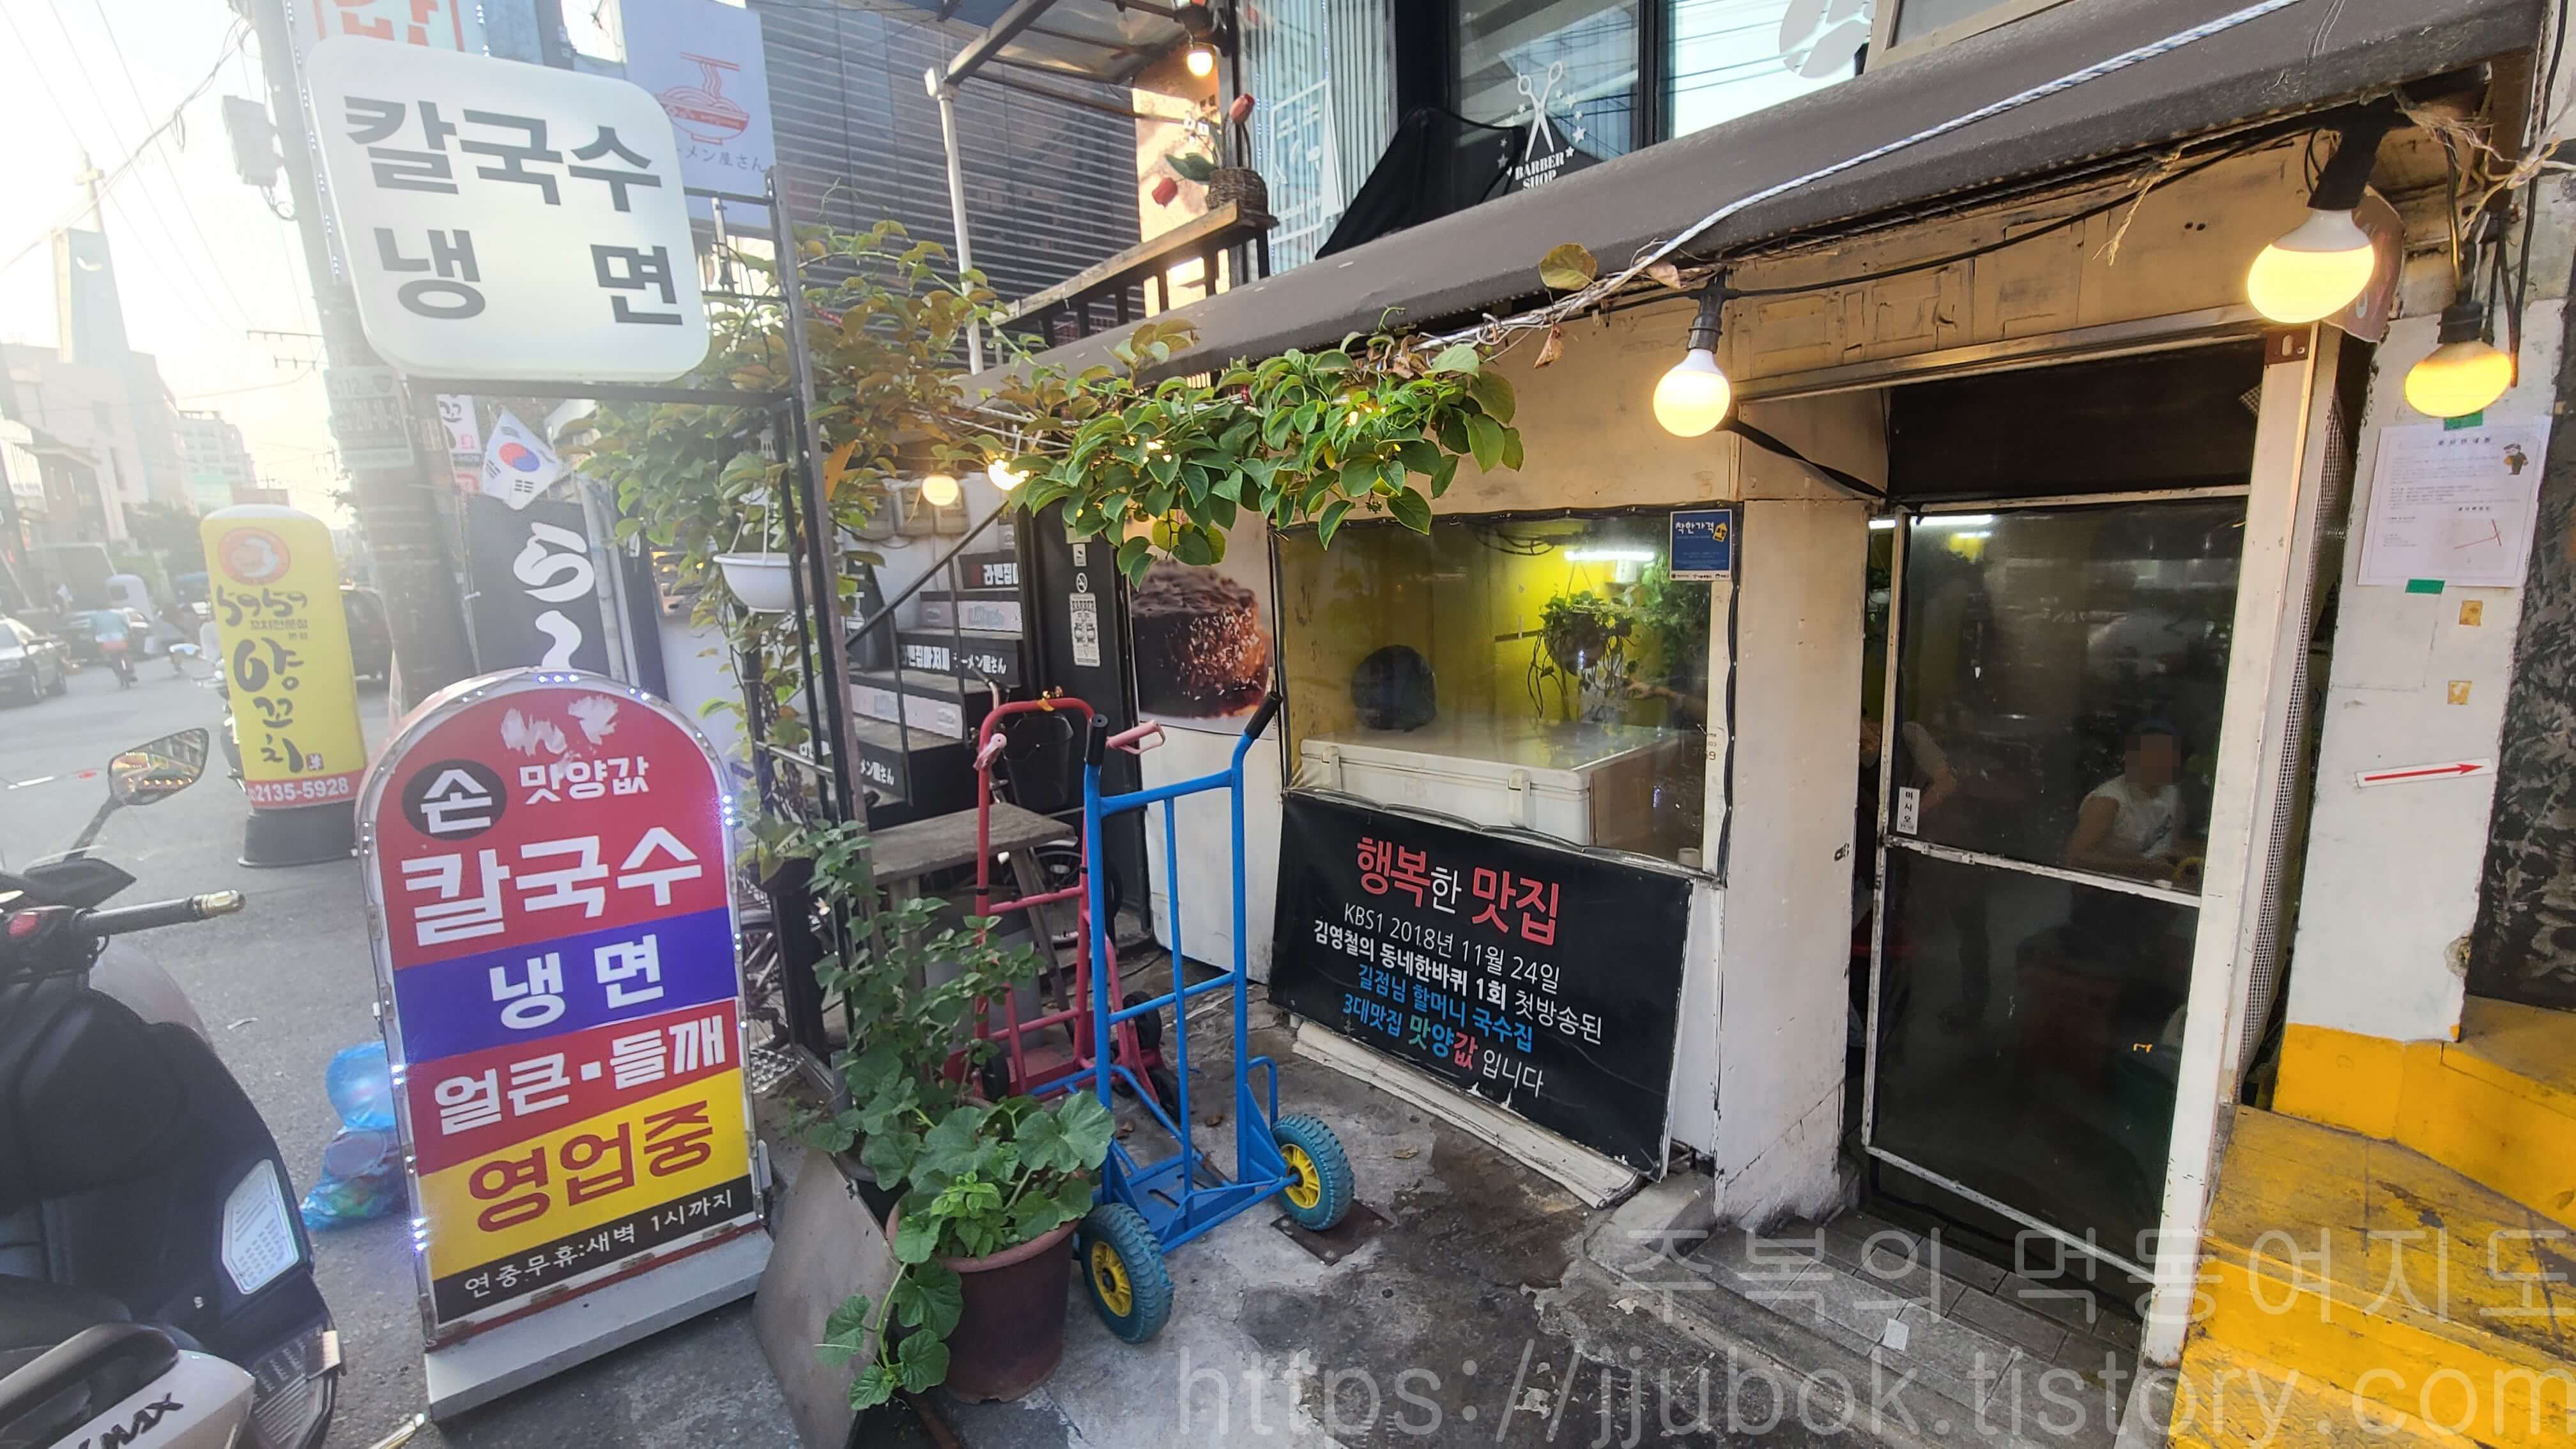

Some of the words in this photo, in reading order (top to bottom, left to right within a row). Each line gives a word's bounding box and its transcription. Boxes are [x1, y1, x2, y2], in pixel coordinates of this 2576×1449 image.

[344, 95, 662, 212] 칼국수
[677, 145, 765, 172] メン屋さん
[1515, 152, 1565, 180] BARBER
[1523, 169, 1557, 190] SHOP
[1675, 521, 1714, 535] 착한가격
[420, 769, 493, 833] 손
[519, 756, 649, 805] 맛양값
[401, 826, 702, 947] 칼국수
[1356, 836, 1462, 915] 행복한
[1471, 866, 1561, 946] 맛집
[1314, 919, 1374, 962] 김영철의
[1379, 942, 1468, 997] 동네한바퀴
[1476, 977, 1506, 1011] 1회
[1514, 990, 1602, 1045] 첫방송된
[1344, 902, 1383, 933] KBS1
[1390, 917, 1453, 958] 2018년
[1462, 940, 1504, 976] 11월
[1510, 956, 1560, 995] 24일
[1342, 993, 1404, 1038] 3대맛집
[1408, 1015, 1478, 1071] 맛양값
[1482, 1049, 1544, 1098] 입니다
[1358, 963, 1406, 1004] 길점님
[1412, 983, 1466, 1028] 할머니
[1472, 1007, 1533, 1054] 국수집
[468, 1100, 714, 1232] 영업중
[650, 1188, 733, 1232] 1시까지
